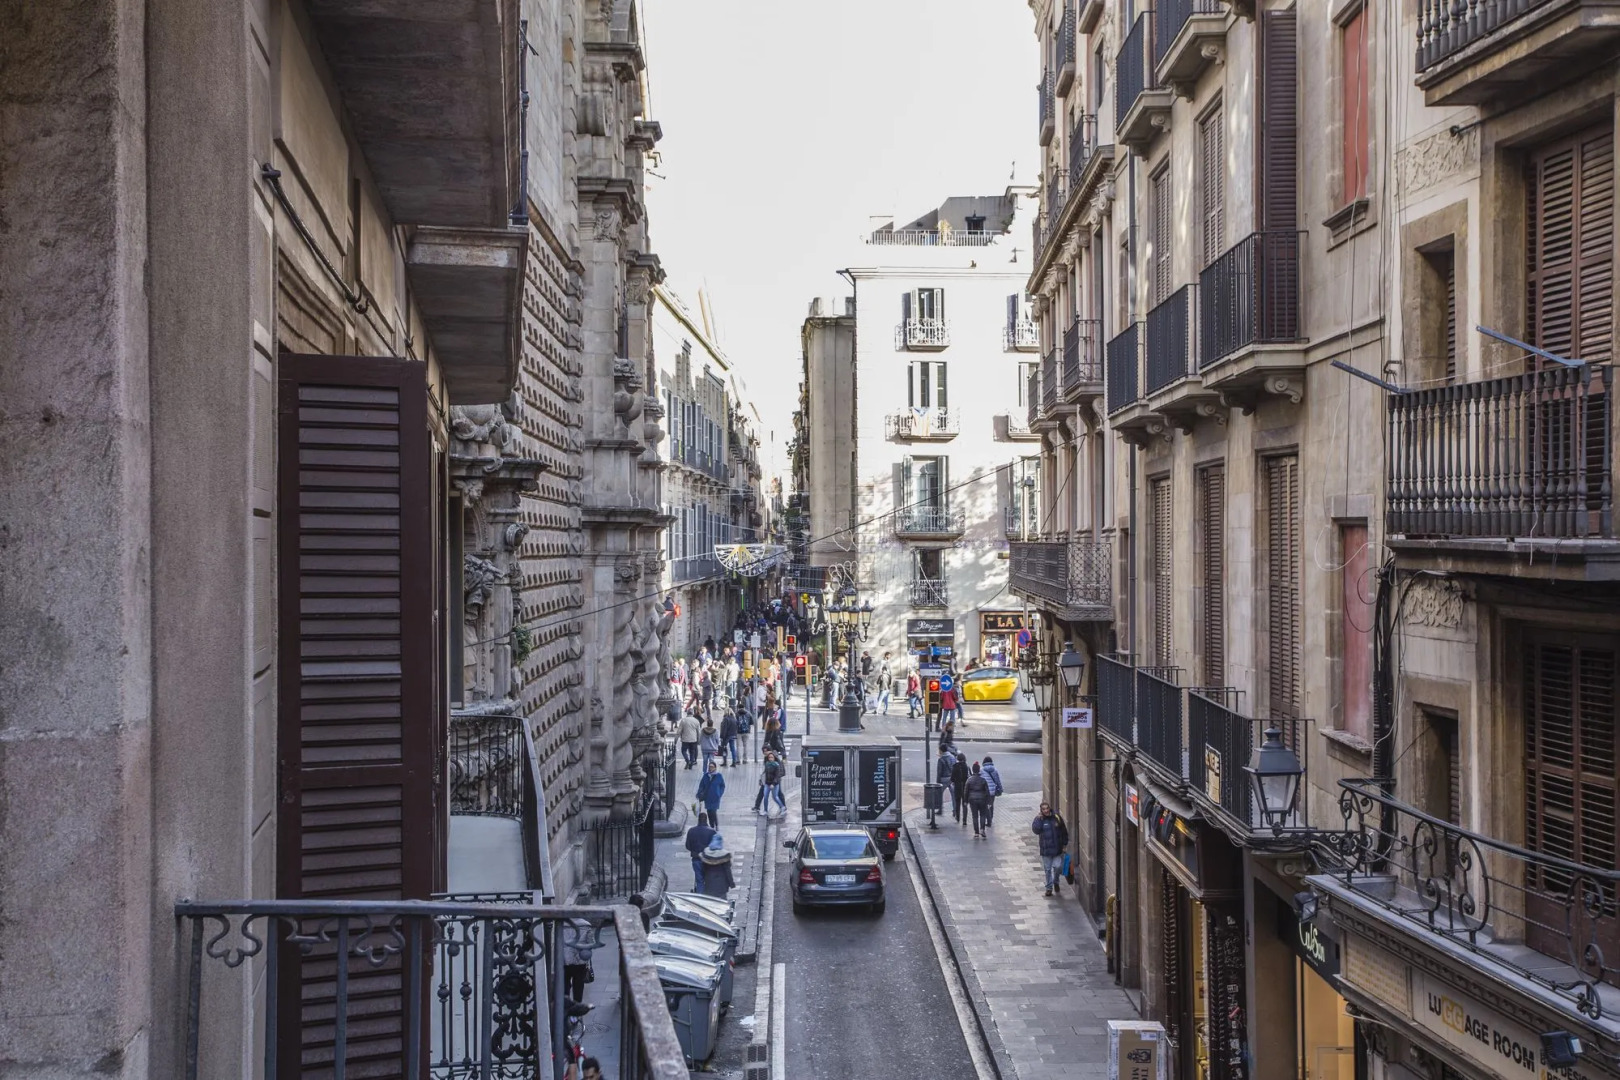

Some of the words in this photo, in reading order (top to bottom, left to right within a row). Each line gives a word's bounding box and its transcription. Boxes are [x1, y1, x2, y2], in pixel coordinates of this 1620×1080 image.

[997, 617, 1015, 628] LA
[819, 764, 843, 773] portem
[818, 771, 838, 779] millor
[1428, 992, 1490, 1046] LUGGAGE
[1493, 1030, 1535, 1073] ROOM
